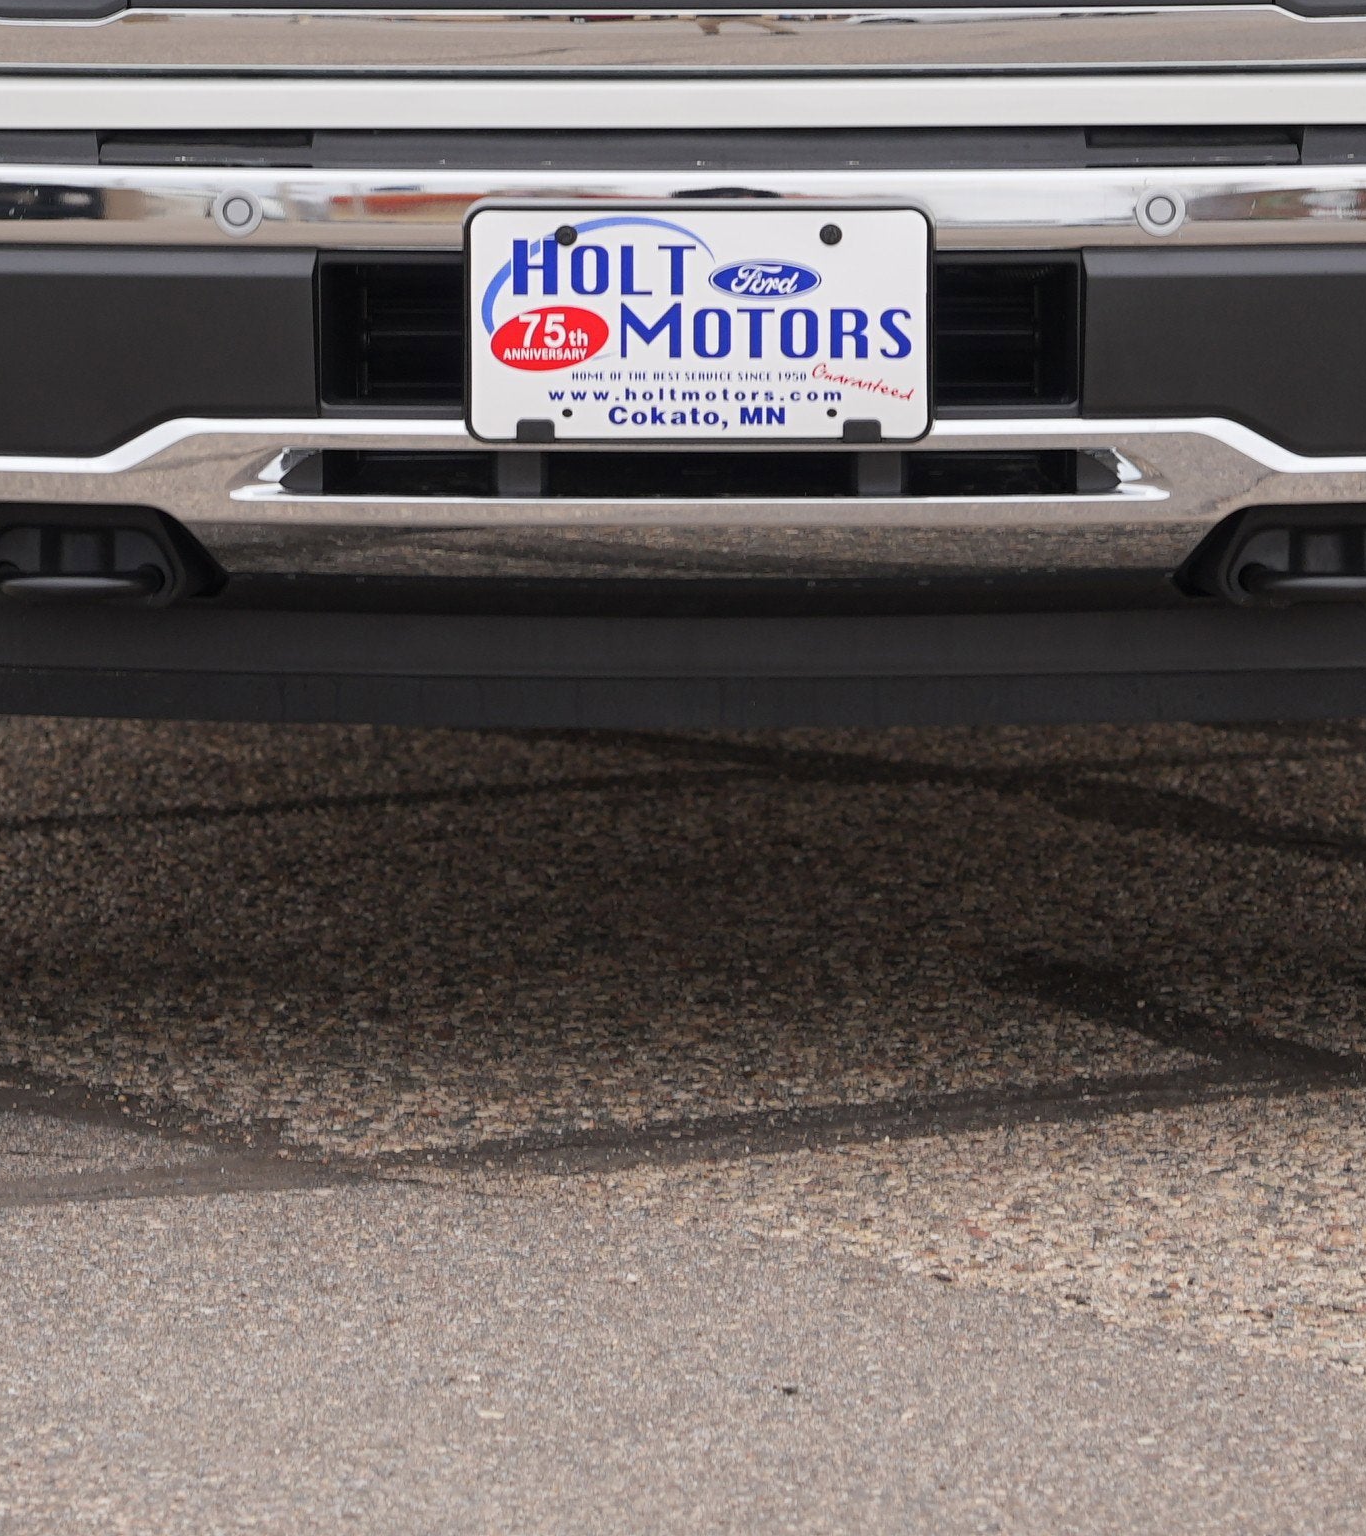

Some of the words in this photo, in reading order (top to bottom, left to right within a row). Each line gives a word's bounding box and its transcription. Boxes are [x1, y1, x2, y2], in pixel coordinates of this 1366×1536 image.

[512, 238, 696, 295] HOLT
[731, 264, 799, 294] Ford
[518, 313, 589, 348] 75th
[620, 302, 912, 359] MOTORS
[503, 347, 588, 361] ANNIVERSARY
[572, 371, 604, 382] HOME
[610, 371, 621, 382] OF
[629, 371, 647, 382] THE
[738, 371, 771, 382] SINCE
[778, 371, 807, 382] 1950
[811, 363, 914, 402] Guaranteed
[548, 388, 842, 401] www.holtmotors.com
[608, 406, 728, 429] Cokato,
[739, 407, 785, 425] MN
